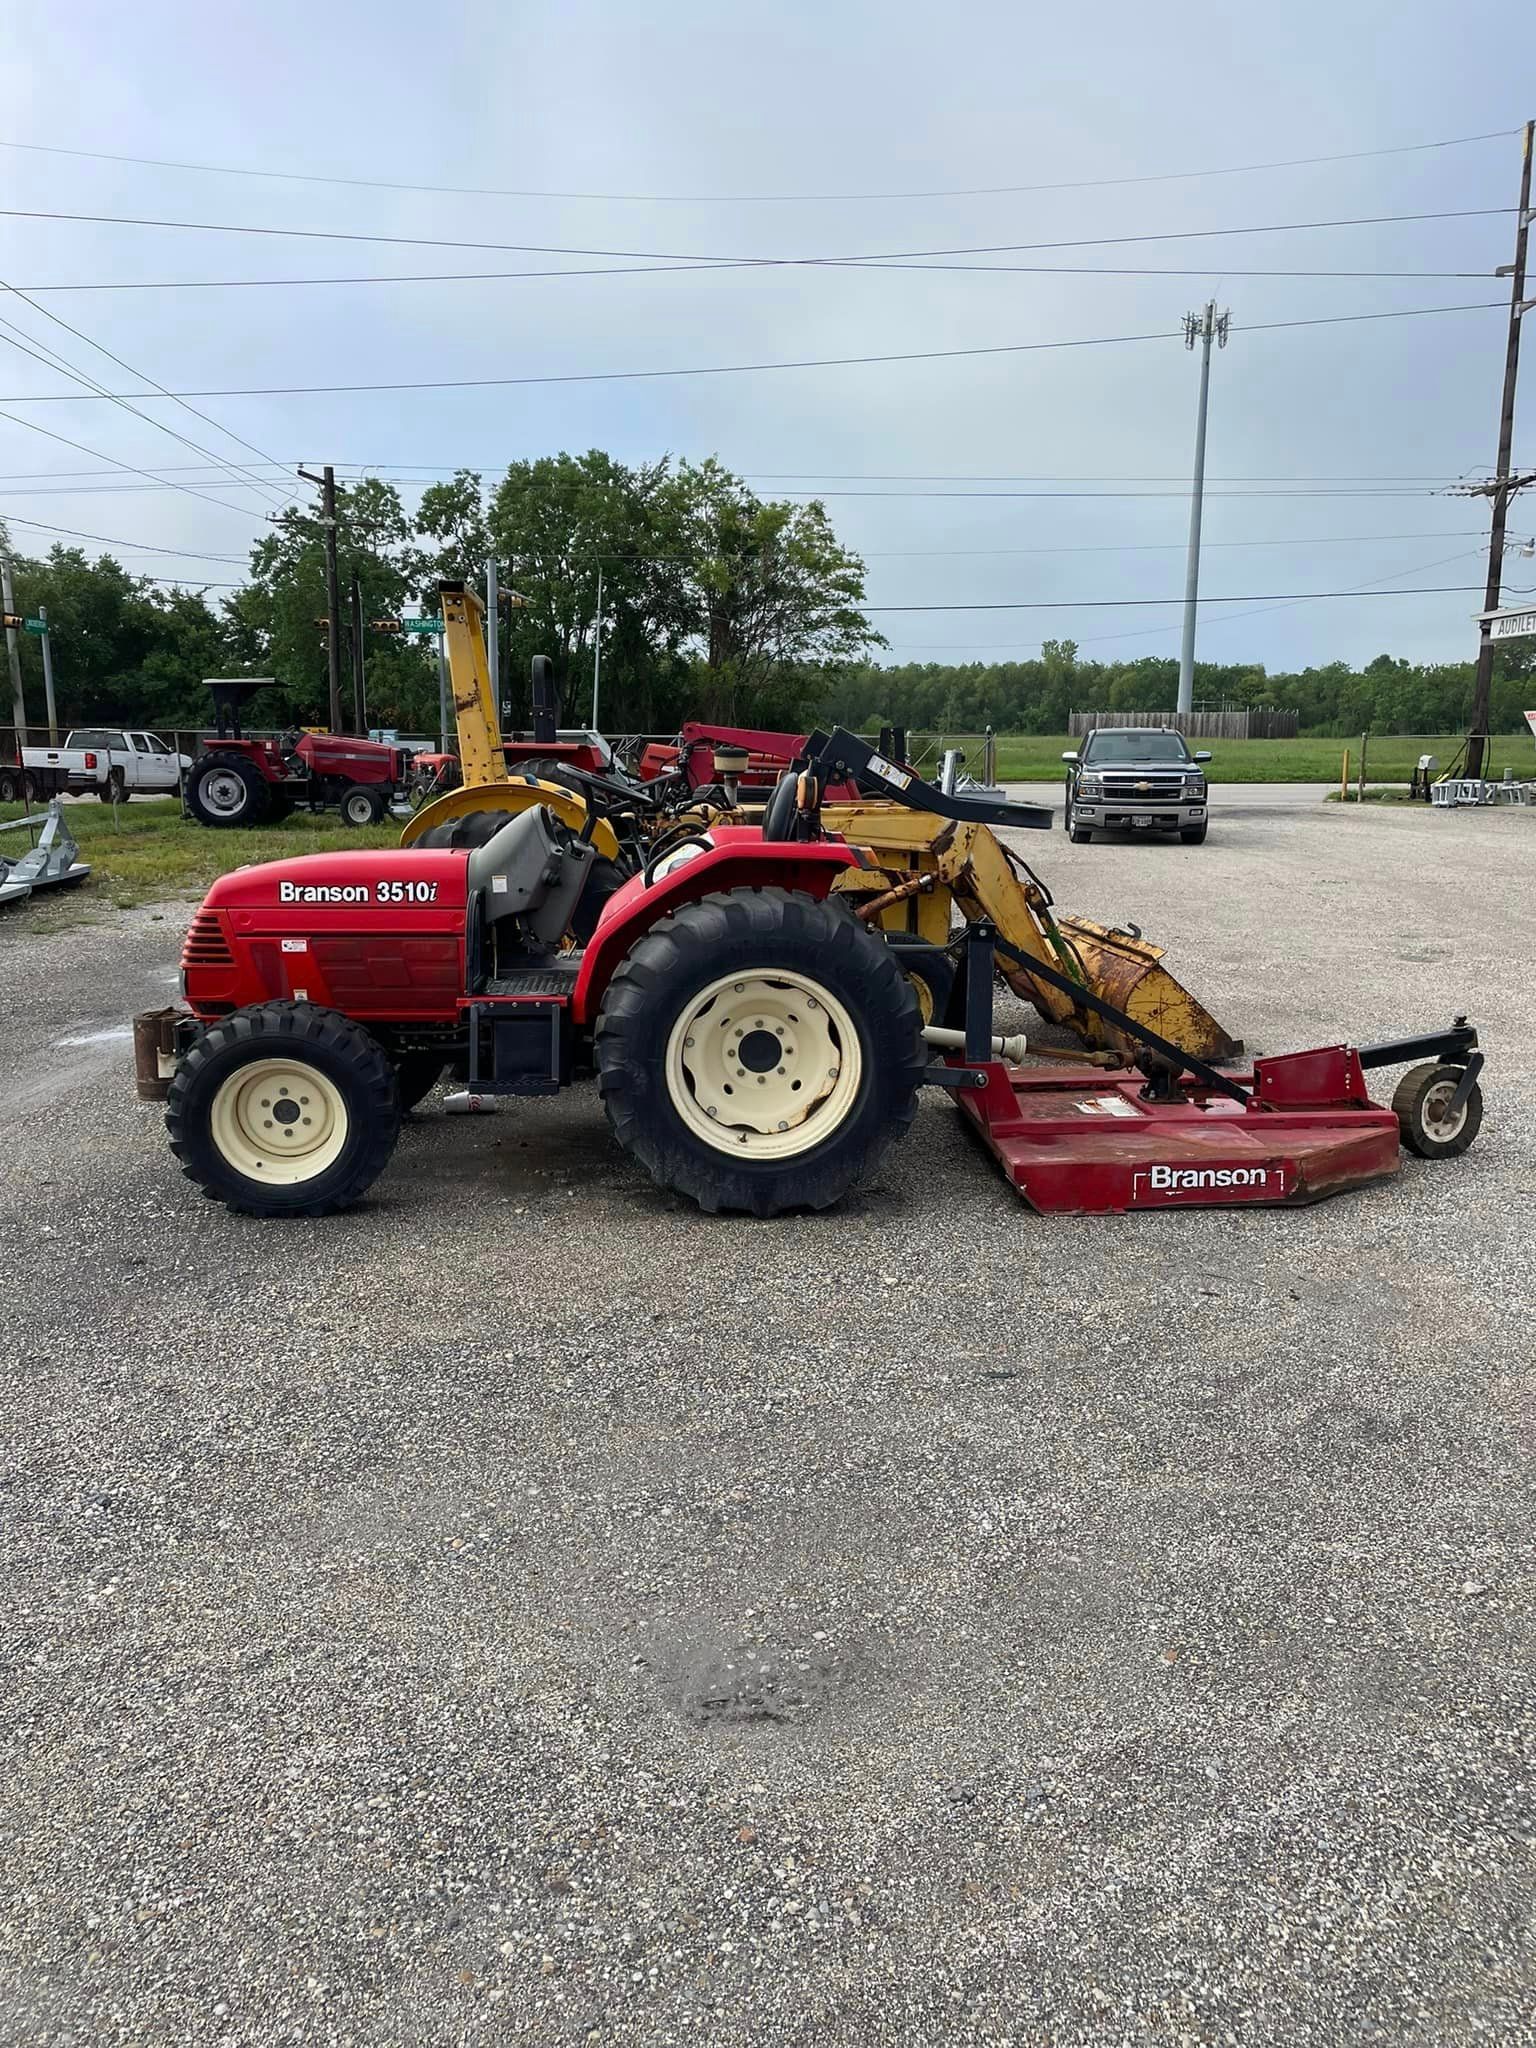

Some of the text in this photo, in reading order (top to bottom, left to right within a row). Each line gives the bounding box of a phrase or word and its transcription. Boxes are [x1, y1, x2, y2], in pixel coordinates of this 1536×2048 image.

[1498, 615, 1536, 635] AUDILET
[280, 881, 437, 902] Branson 3510i
[1151, 1165, 1266, 1189] Branson
